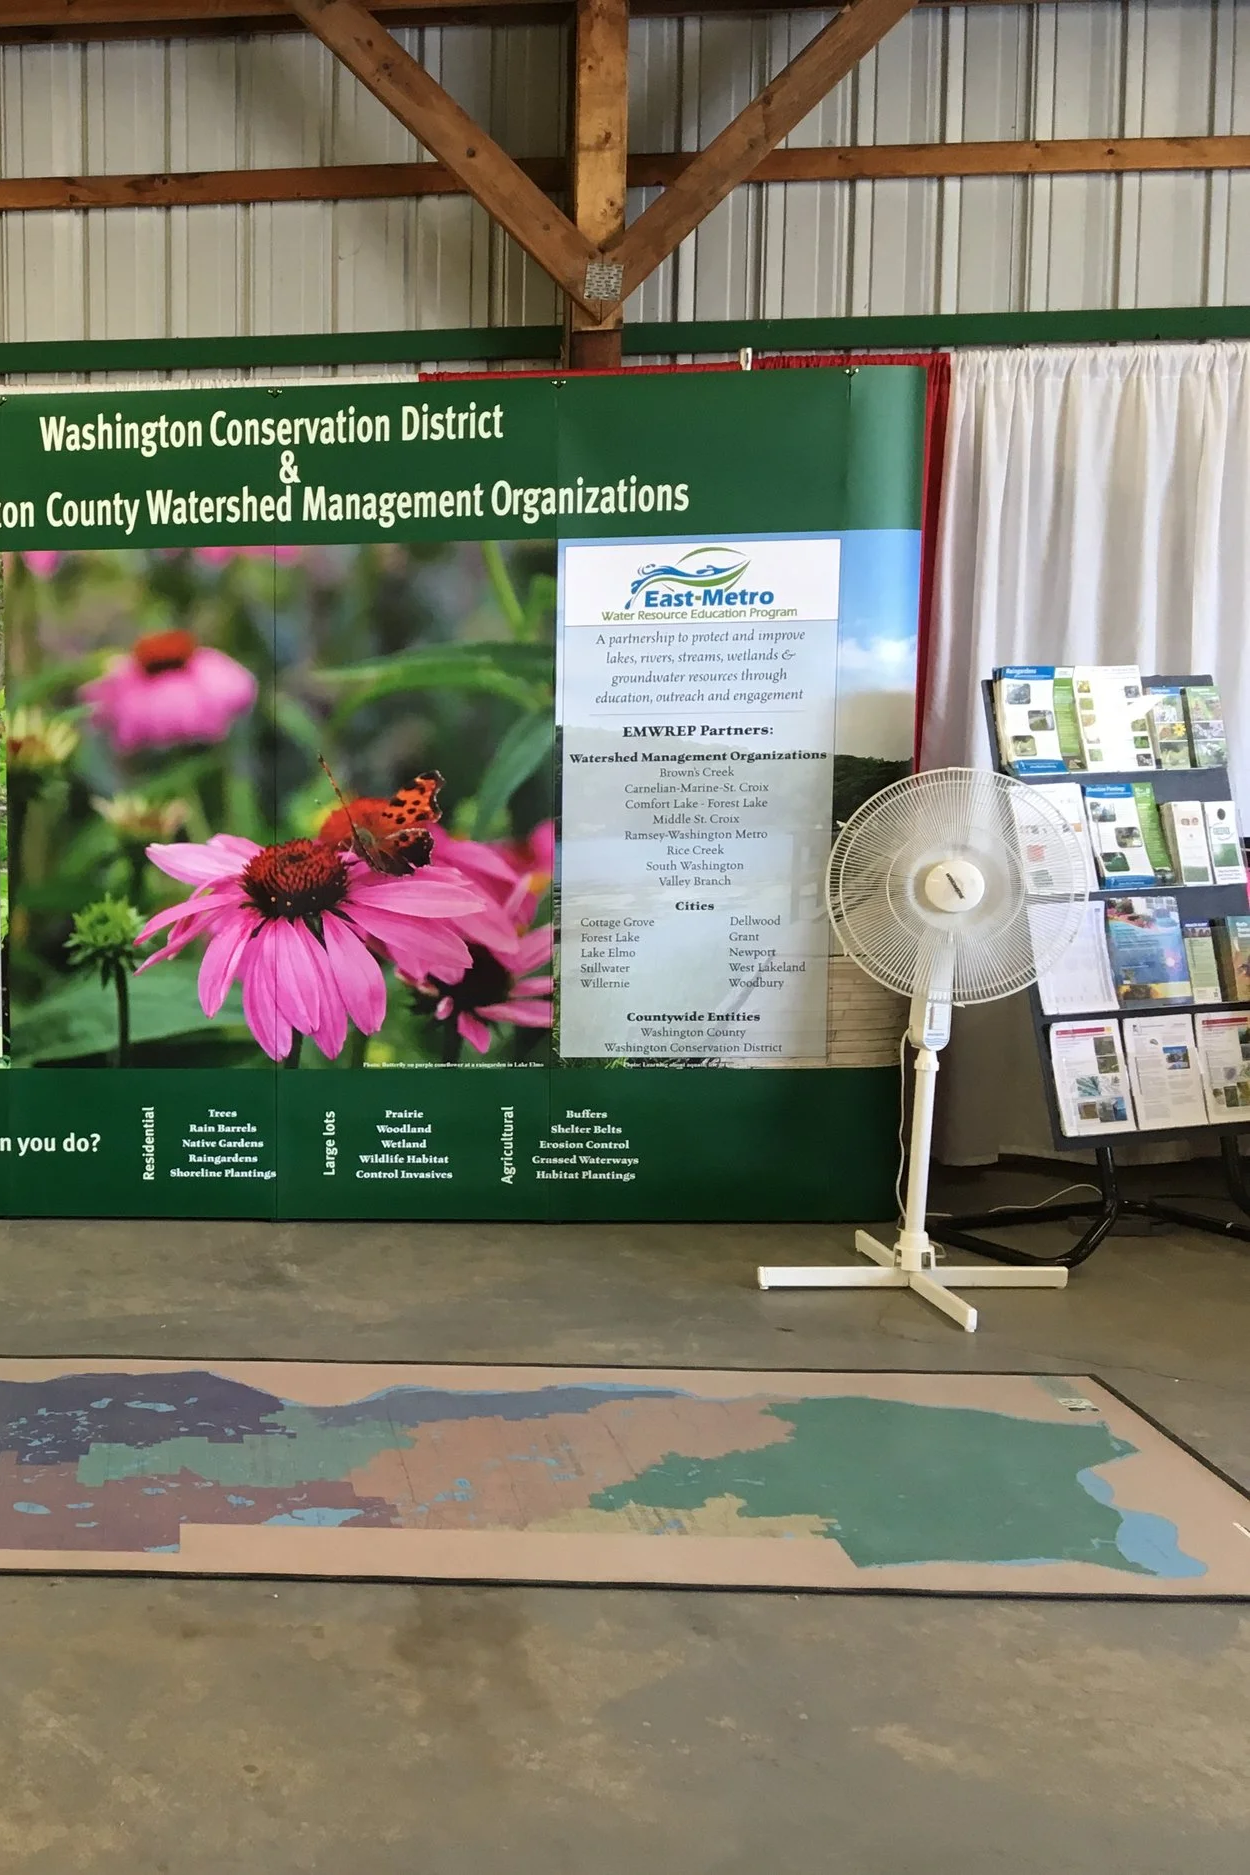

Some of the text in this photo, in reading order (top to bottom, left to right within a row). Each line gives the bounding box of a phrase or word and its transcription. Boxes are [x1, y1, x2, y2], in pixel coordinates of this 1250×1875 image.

[39, 403, 504, 457] Washington Conservation District
[279, 450, 301, 484] &
[46, 491, 140, 535] County
[146, 484, 292, 523] Watershed
[302, 485, 484, 528] Management
[491, 475, 689, 524] Organizations
[644, 588, 774, 607] East-Metro
[602, 607, 797, 621] Water Resource Education Program
[595, 629, 805, 648] A partnership to protect and improve
[622, 725, 774, 738] EMWREP Partners:
[570, 749, 827, 764] Watershed Management Organizations
[702, 766, 734, 777] Creek
[653, 813, 739, 825] Middle St. Croix
[675, 901, 715, 911] Cities
[580, 917, 655, 929] Cottage Grove
[730, 916, 781, 926] Dellwood
[729, 932, 759, 942] Grant
[580, 963, 630, 974] Stillwater
[729, 977, 784, 990] Woodbury
[627, 1011, 760, 1023] Countywide Entities
[604, 1042, 782, 1055] Washington Conservation District
[208, 1109, 237, 1118] Trees
[385, 1110, 424, 1119] Prairie
[566, 1110, 607, 1119] Buffers
[189, 1124, 257, 1133] Rain Barrels
[376, 1124, 432, 1134] Woodland
[550, 1124, 622, 1134] Shelter Belts
[18, 1136, 56, 1157] you
[62, 1133, 101, 1153] do?
[142, 1106, 155, 1181] Residential
[182, 1139, 264, 1148] Native Gardens
[322, 1111, 338, 1175] Large lots
[381, 1140, 427, 1148] Wetland
[500, 1106, 516, 1185] Agricultural
[539, 1140, 630, 1149] Erosion Control
[188, 1154, 258, 1165] Raingardens
[359, 1154, 449, 1164] Wildlife Habitat
[531, 1155, 639, 1166] Grassed Waterways
[170, 1169, 277, 1180] Shoreline Plantings
[355, 1170, 453, 1179] Control Invasives
[536, 1170, 636, 1181] Habitat Plantings
